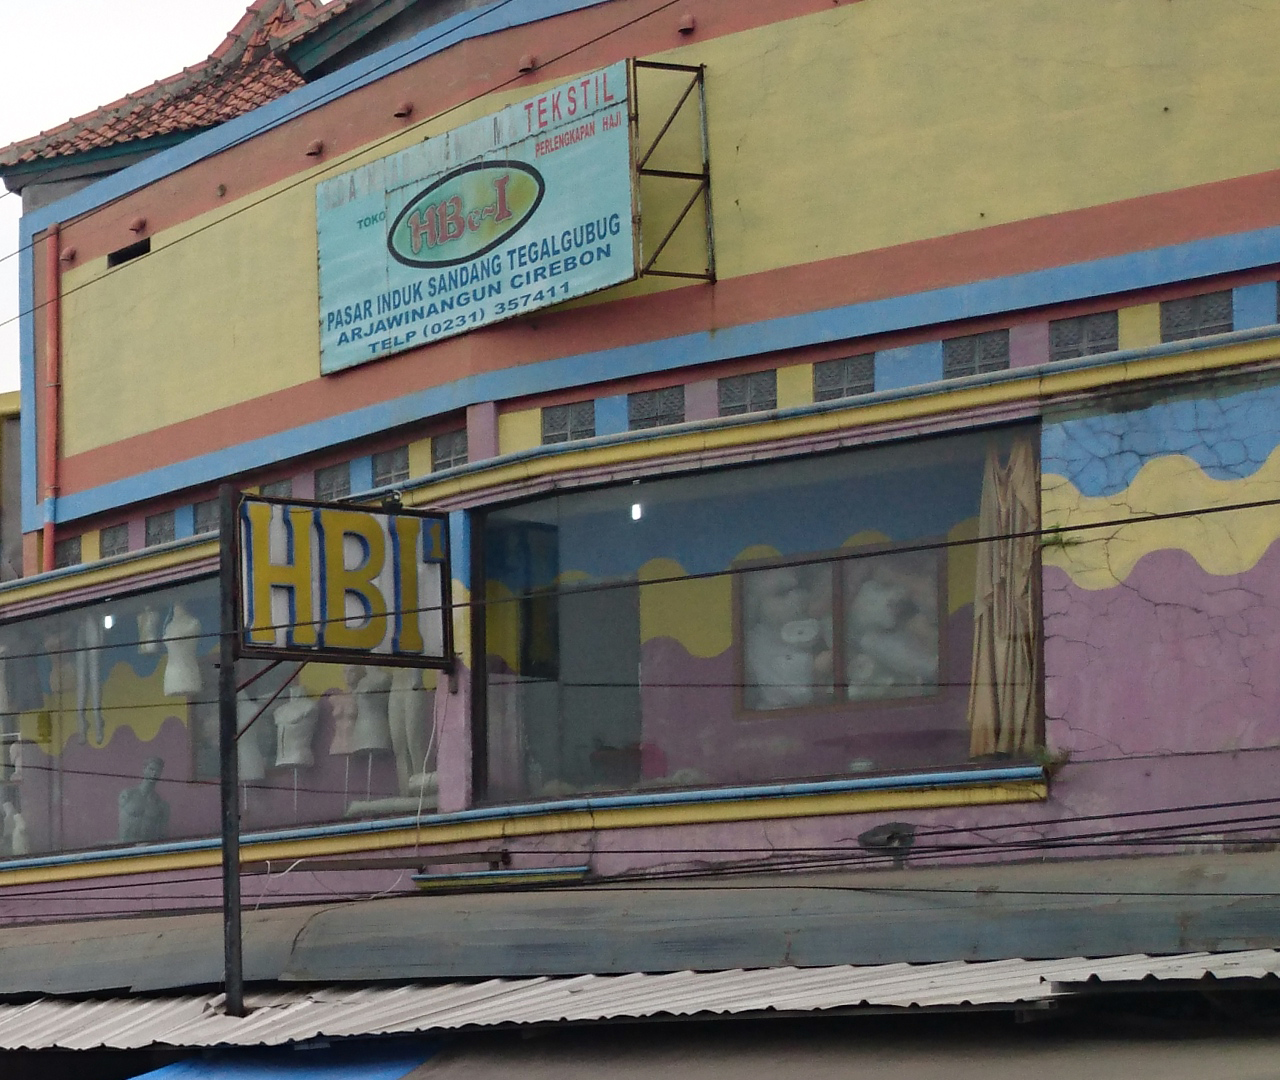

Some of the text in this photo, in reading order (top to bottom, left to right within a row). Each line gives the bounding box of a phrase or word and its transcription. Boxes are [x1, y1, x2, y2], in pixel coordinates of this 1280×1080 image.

[524, 73, 614, 133] TEKSTIL
[535, 111, 622, 158] PERLENGKAPAN HAJI
[356, 211, 387, 231] TOKO
[327, 213, 620, 331] PASAR INDUK SANDANG TEGALGUBUG
[336, 243, 612, 347] ARJAWINANGUN CIREBON
[368, 281, 570, 354] TELP (0231) 357411
[242, 501, 424, 654] HBI
